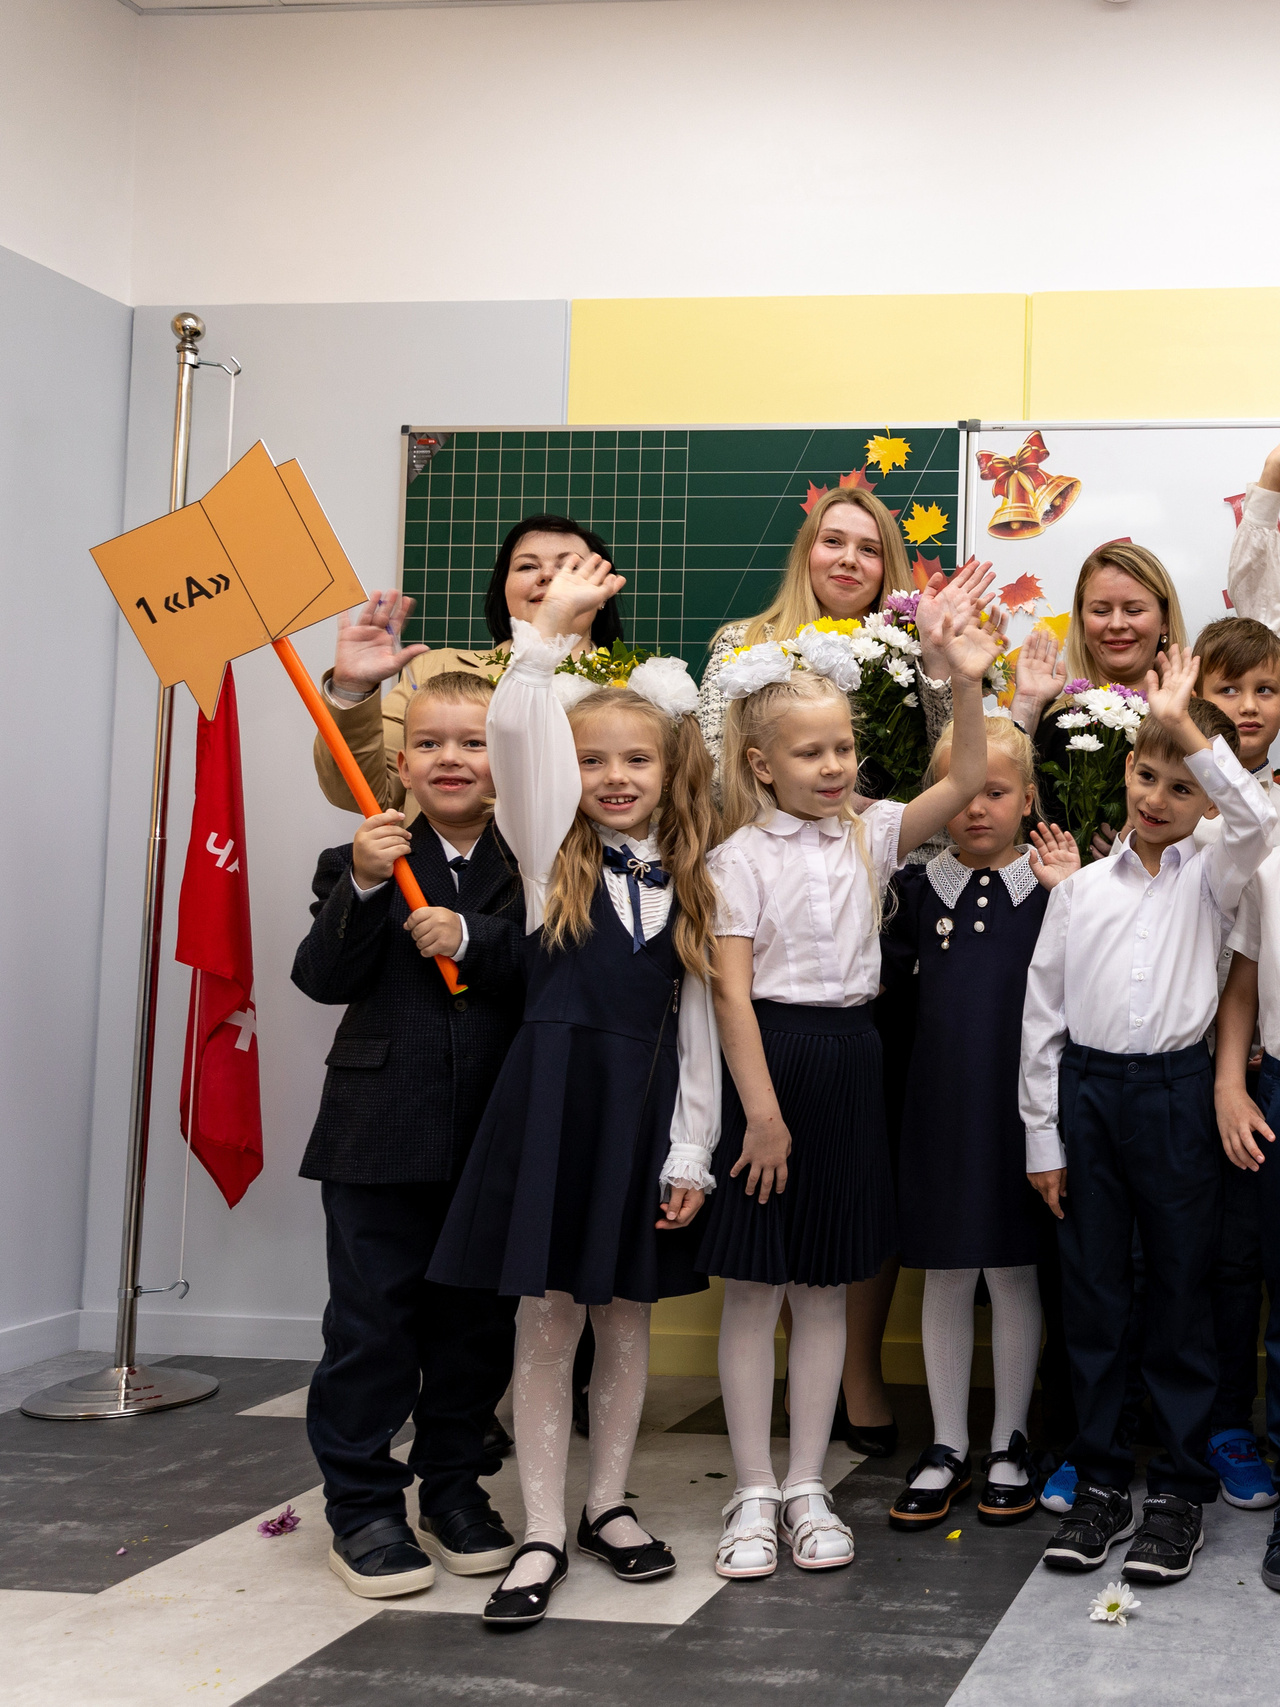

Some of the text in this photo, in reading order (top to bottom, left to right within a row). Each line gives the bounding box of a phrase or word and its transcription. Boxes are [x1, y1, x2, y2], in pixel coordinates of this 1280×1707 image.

[135, 573, 230, 624] 1 «А»
[1088, 1487, 1110, 1498] VIKING
